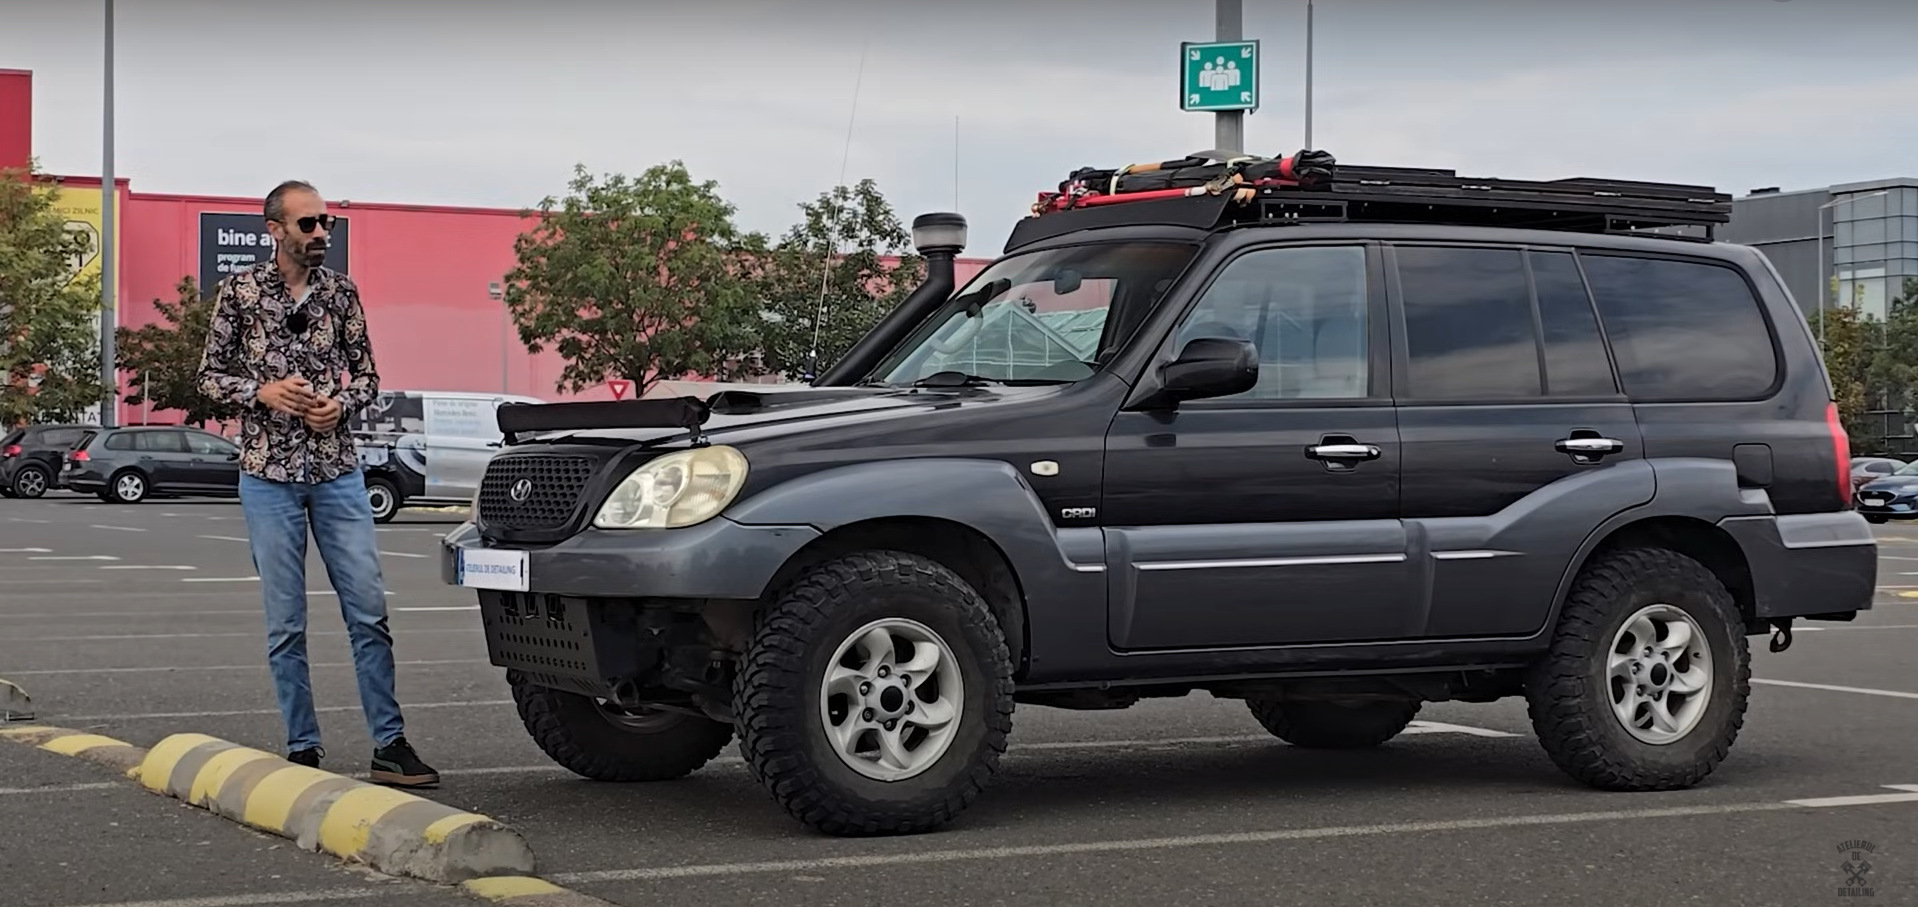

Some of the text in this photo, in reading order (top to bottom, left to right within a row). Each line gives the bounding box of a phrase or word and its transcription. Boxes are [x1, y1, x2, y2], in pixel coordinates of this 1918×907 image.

[217, 228, 257, 246] bine
[217, 253, 256, 263] program
[217, 263, 229, 272] de
